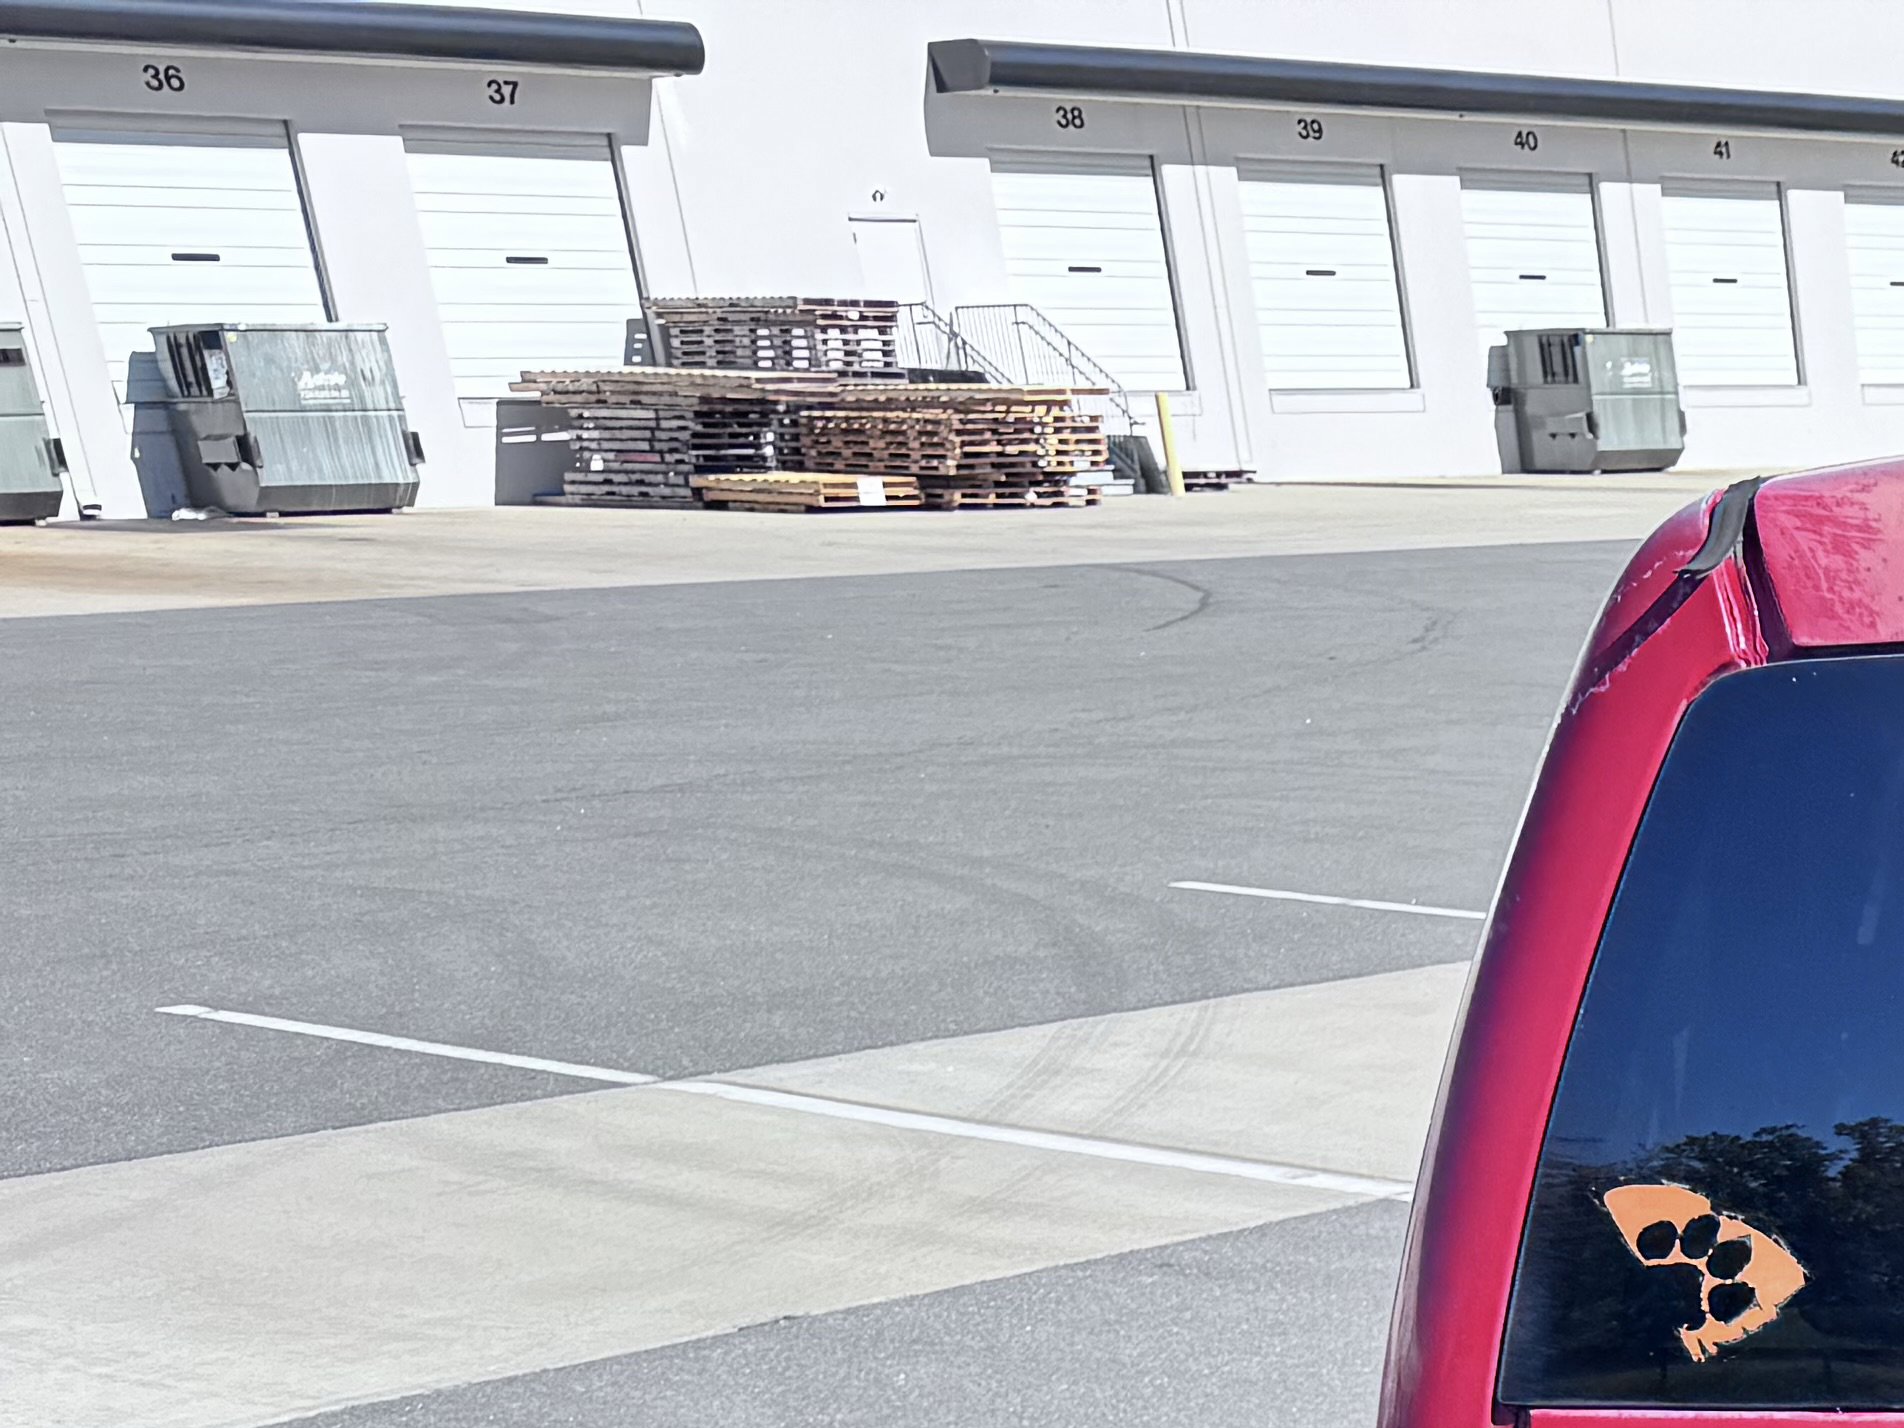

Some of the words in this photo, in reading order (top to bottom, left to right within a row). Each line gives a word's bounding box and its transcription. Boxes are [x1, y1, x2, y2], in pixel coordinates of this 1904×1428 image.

[142, 64, 185, 92] 36
[487, 79, 519, 105] 37
[1055, 106, 1085, 129] 38
[1297, 119, 1323, 140] 39
[1514, 130, 1538, 151] 40
[1713, 140, 1731, 160] 41
